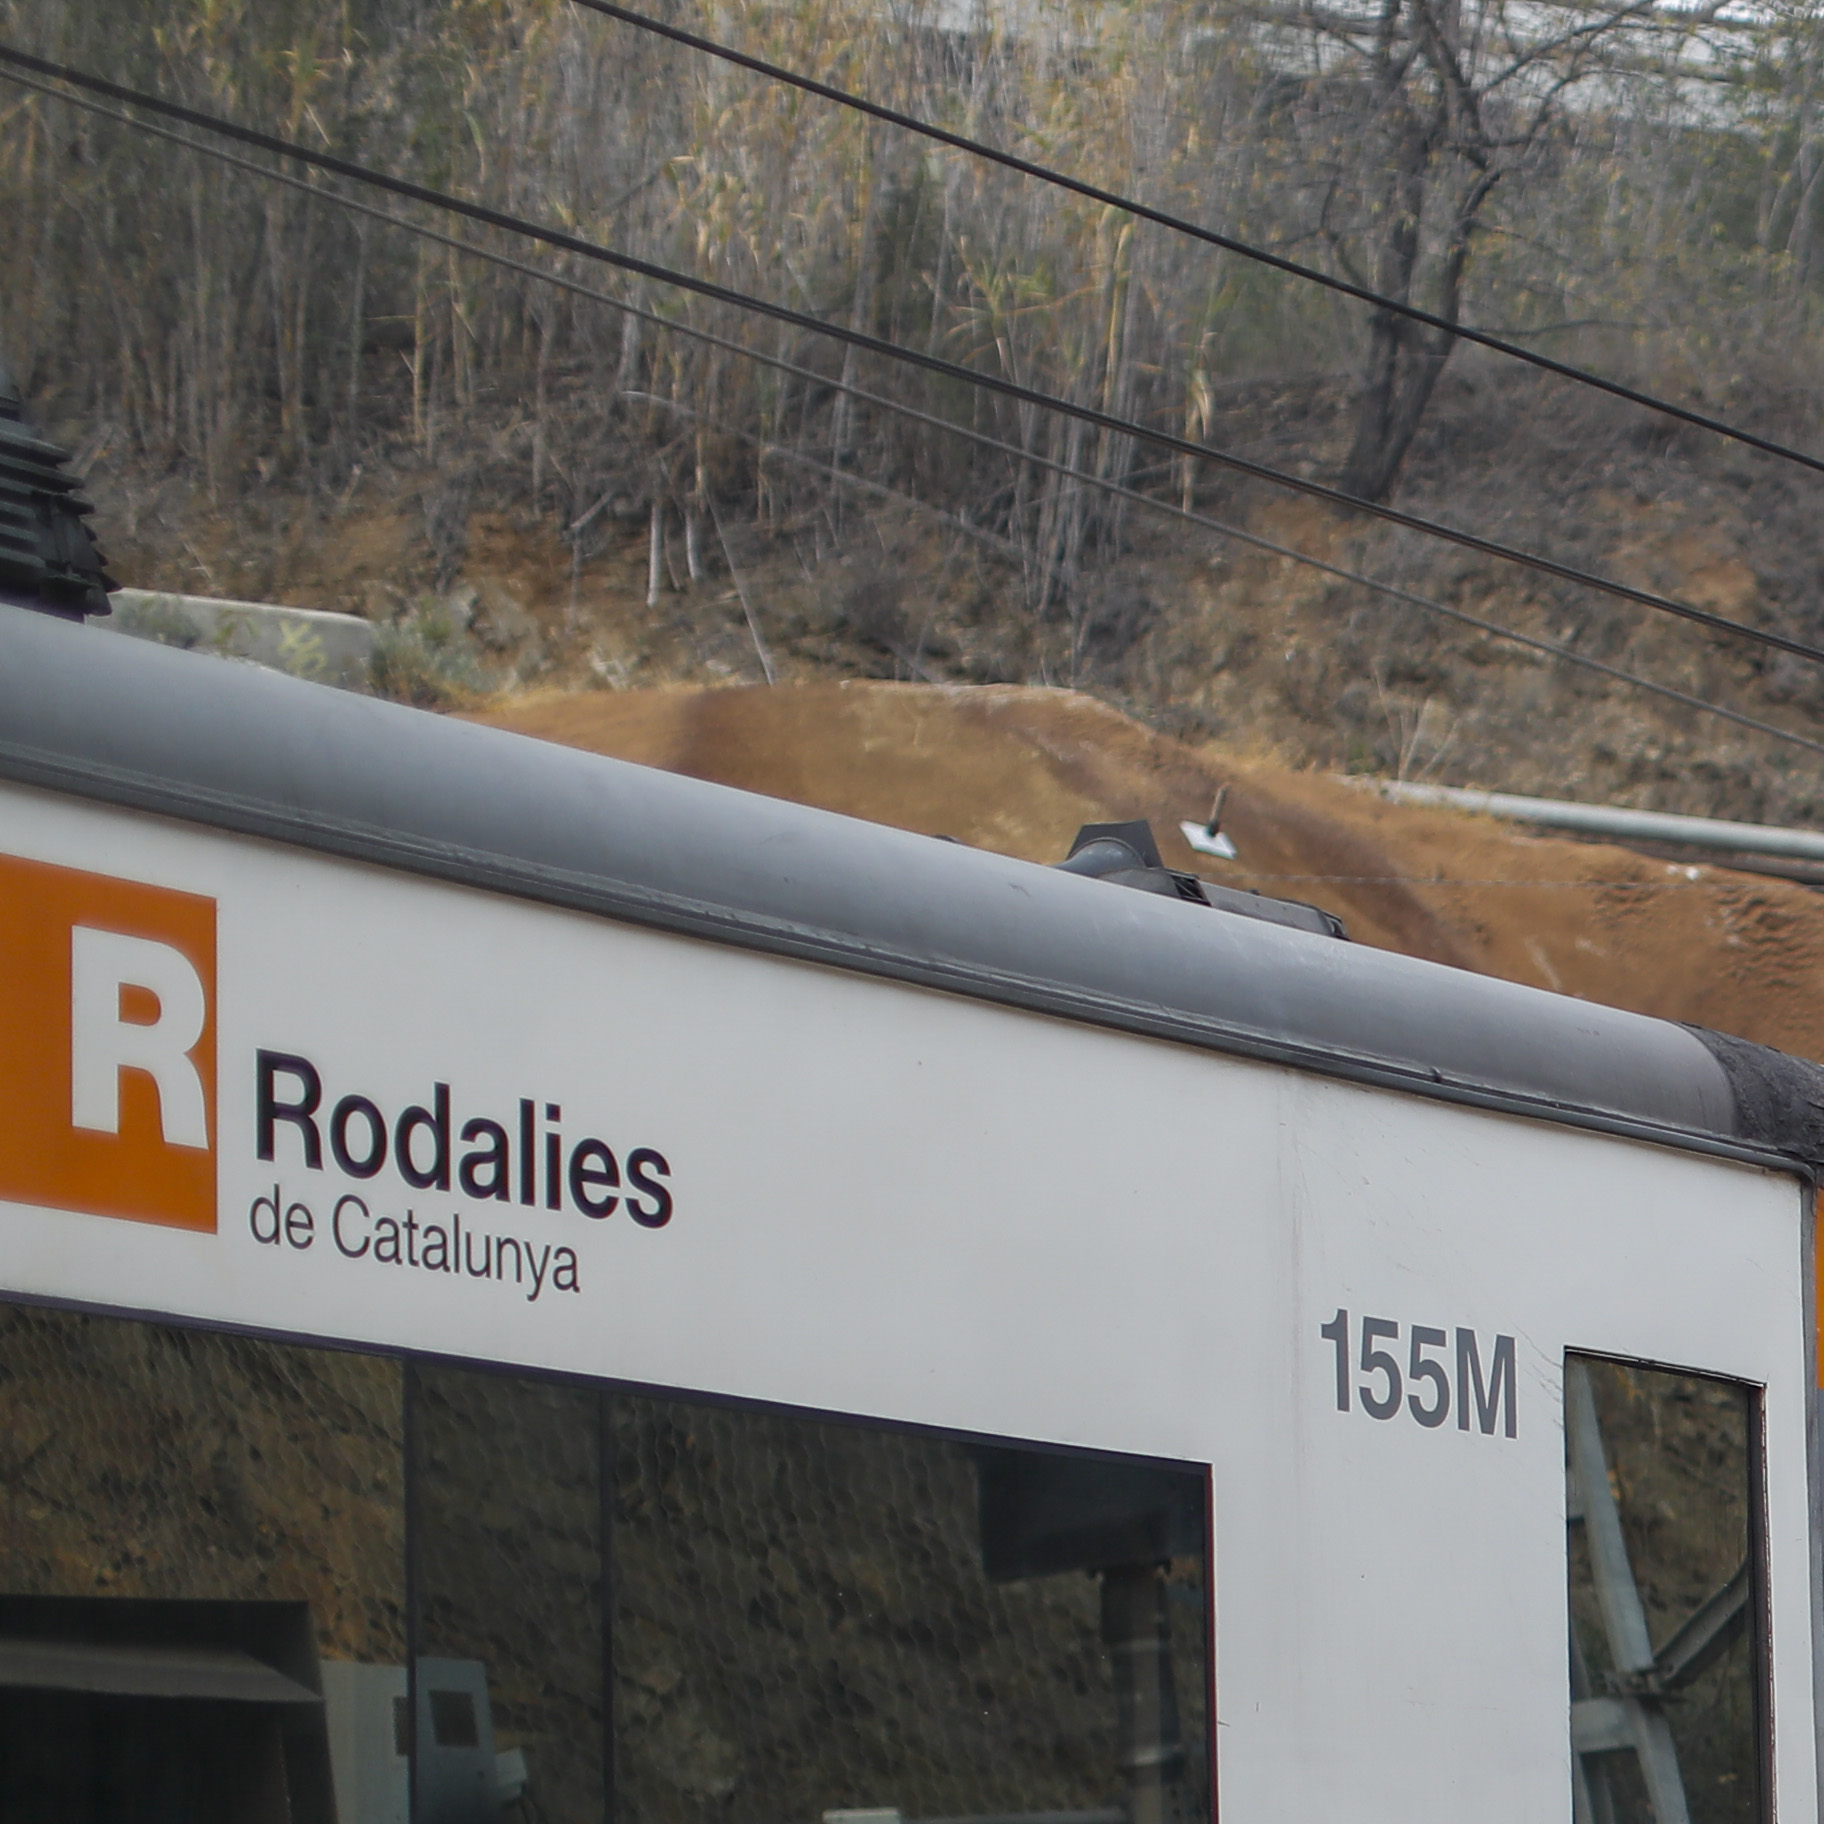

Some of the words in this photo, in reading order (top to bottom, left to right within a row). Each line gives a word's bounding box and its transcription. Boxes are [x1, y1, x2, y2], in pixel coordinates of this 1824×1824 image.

[71, 924, 210, 1151] R
[255, 1047, 673, 1230] Rodalies
[249, 1184, 315, 1250] de
[331, 1193, 581, 1302] Catalunya
[1320, 1307, 1518, 1440] 155M
